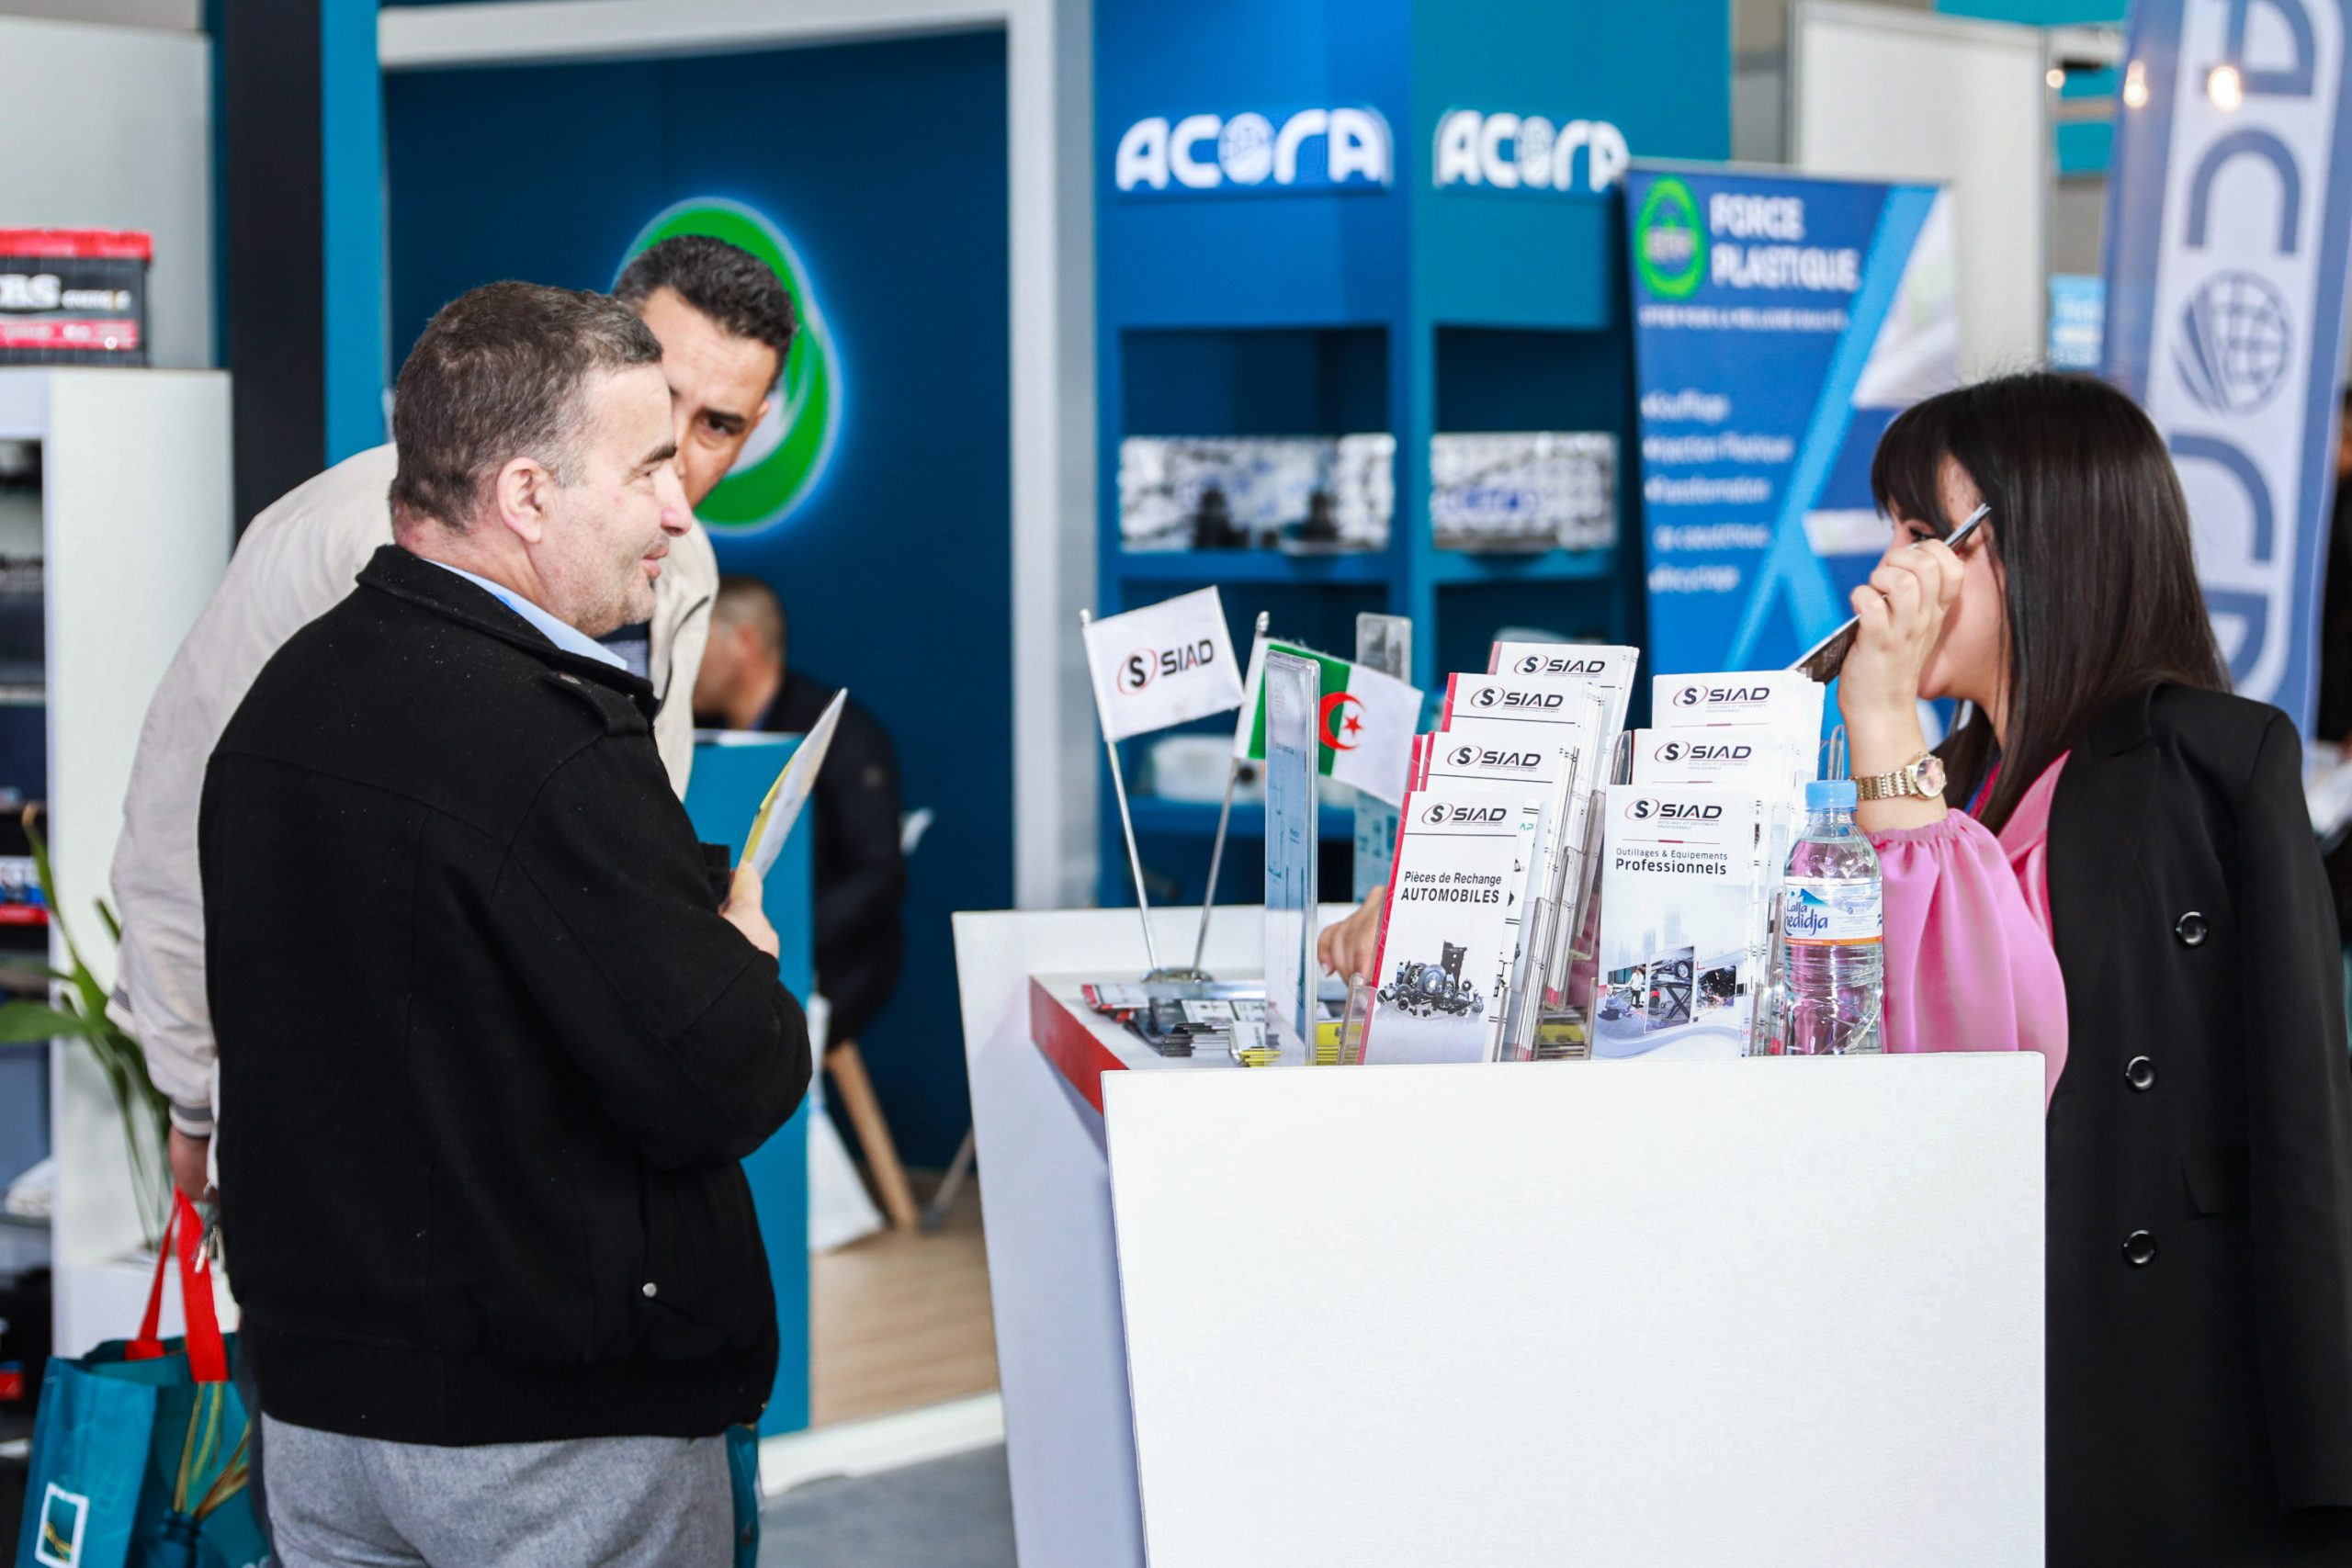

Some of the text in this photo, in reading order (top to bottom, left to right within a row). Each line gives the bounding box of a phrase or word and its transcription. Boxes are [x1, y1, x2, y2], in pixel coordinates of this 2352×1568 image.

[1115, 107, 1391, 190] ACORA
[1710, 193, 1804, 241] FORCE
[1711, 243, 1861, 291] PLASTIQUE
[1160, 638, 1214, 677] SIAD
[1547, 660, 1606, 673] SIAD
[1504, 693, 1564, 708] SIAD
[1708, 687, 1770, 703] SIAD
[1481, 750, 1542, 767] SIAD
[1690, 746, 1752, 759] SIAD
[1452, 807, 1507, 822] SIAD
[1659, 804, 1723, 819] SIAD
[1616, 847, 1659, 858] Outillages
[1661, 850, 1668, 858] &
[1615, 858, 1726, 875] Professionnels
[1404, 871, 1502, 887] Pièces de Rechange
[1400, 887, 1499, 904] AUTOMOBILES
